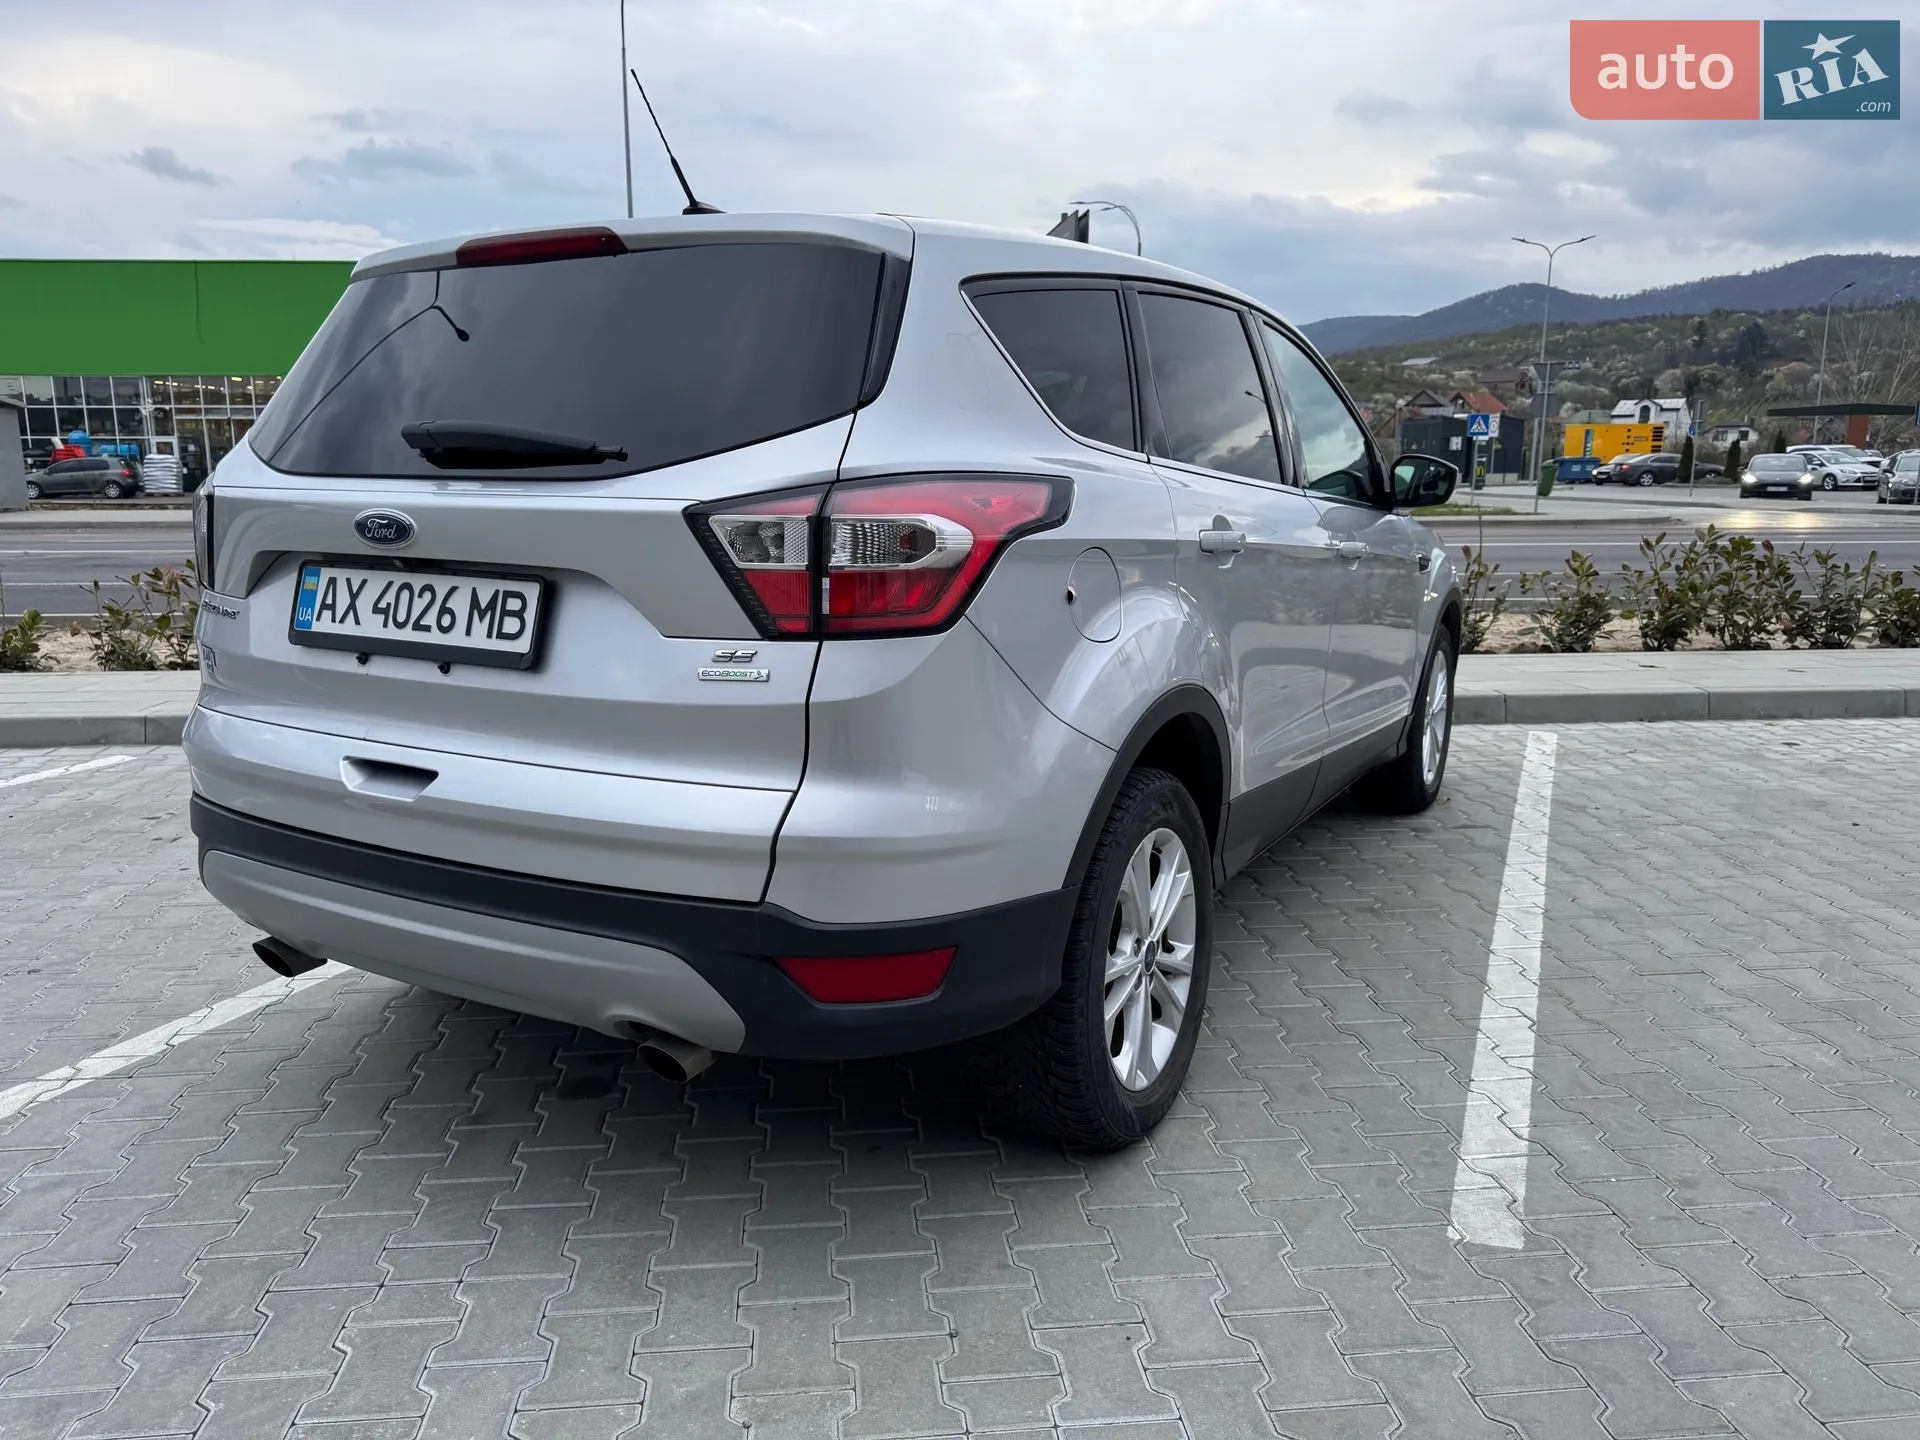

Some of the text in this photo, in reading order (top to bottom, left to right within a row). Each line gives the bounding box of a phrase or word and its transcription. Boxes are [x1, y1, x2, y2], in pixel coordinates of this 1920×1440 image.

[365, 518, 397, 539] Ford
[298, 606, 313, 622] UA
[315, 576, 528, 641] AX 4026 MB
[711, 649, 758, 663] SE
